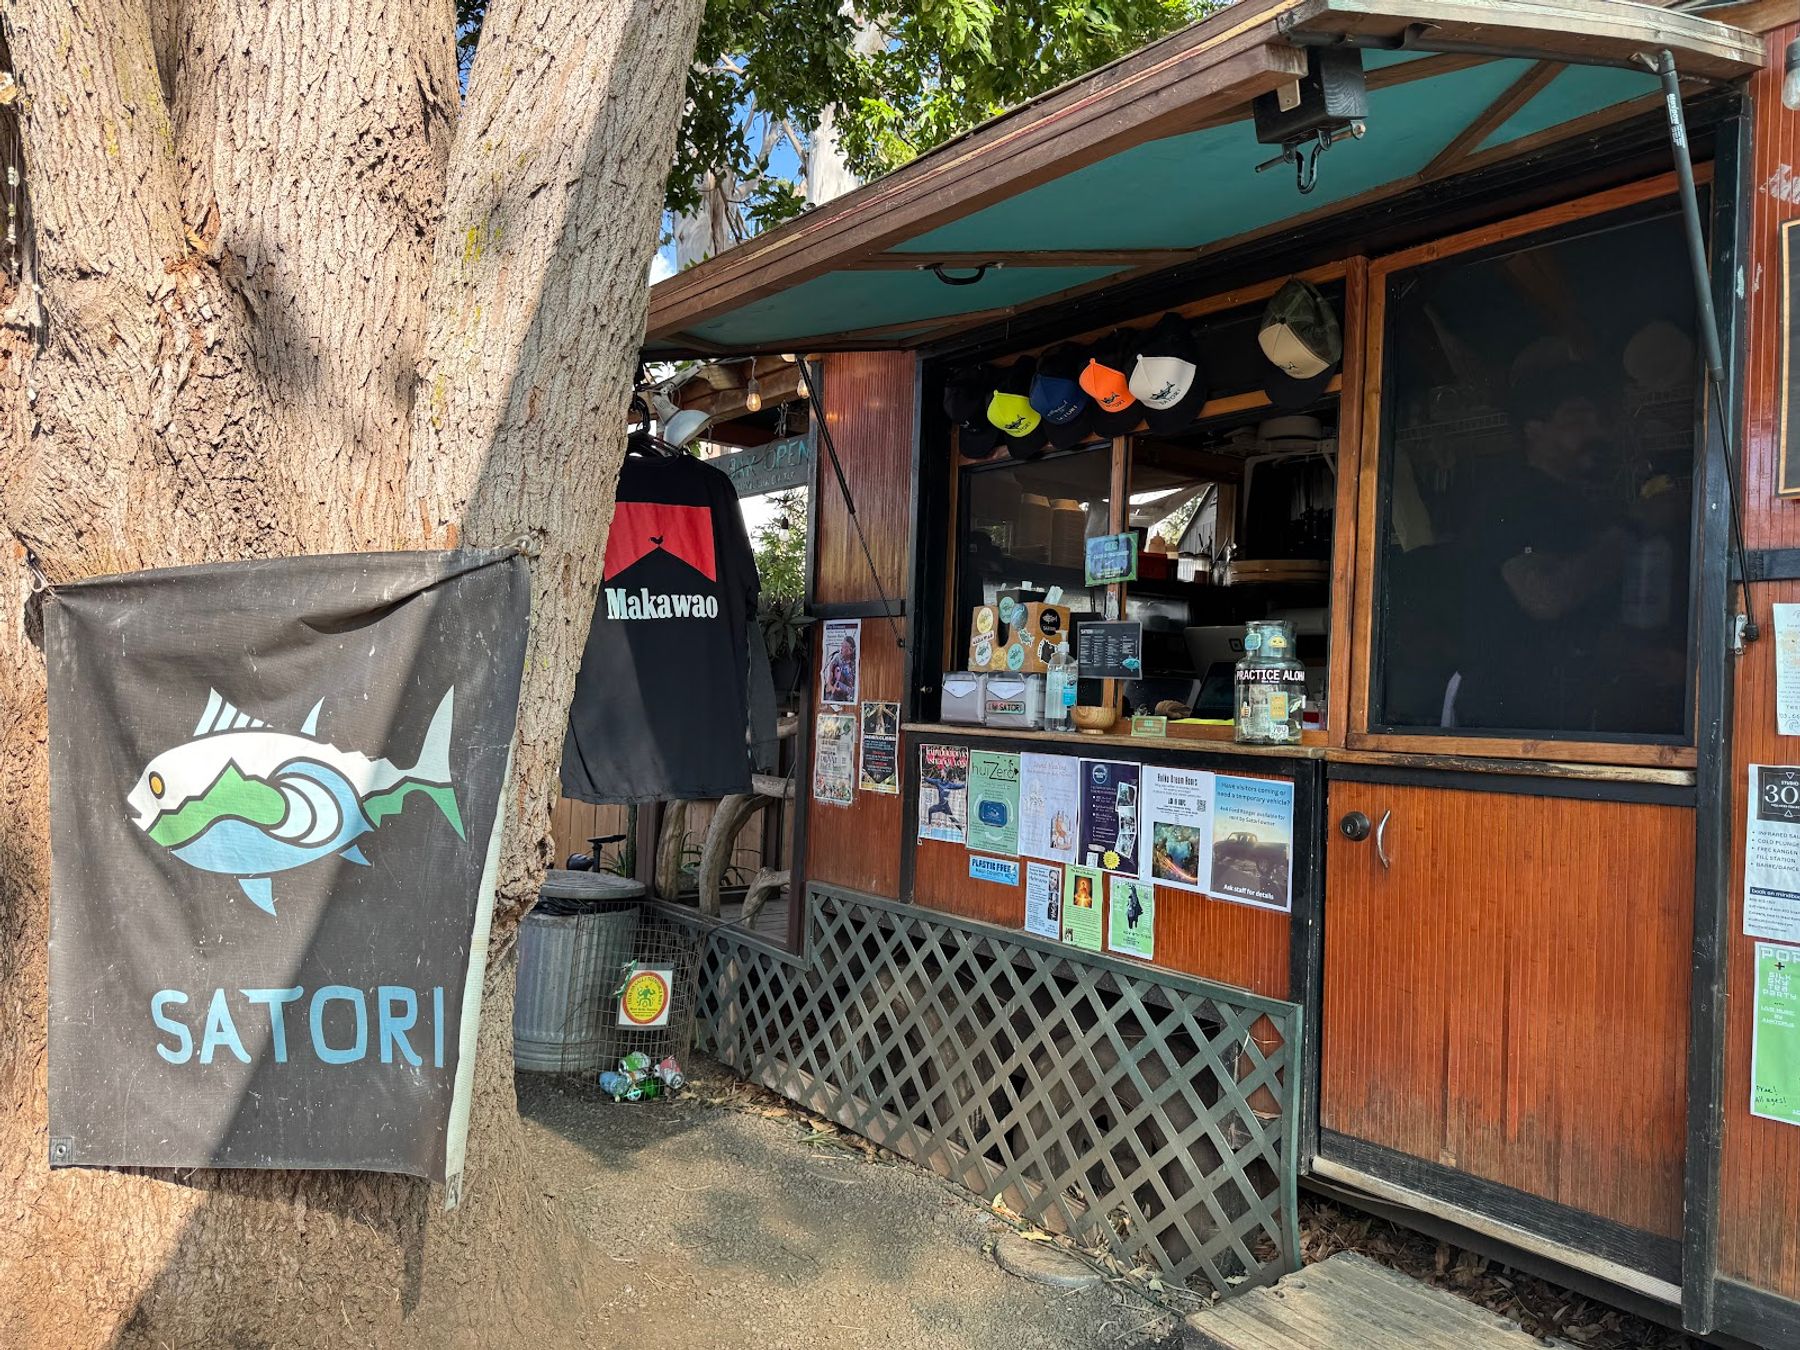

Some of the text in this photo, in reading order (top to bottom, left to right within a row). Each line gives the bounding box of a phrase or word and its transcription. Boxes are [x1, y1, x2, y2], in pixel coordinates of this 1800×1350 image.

[604, 588, 718, 619] Makawao
[1236, 669, 1280, 681] PRACTICE
[151, 985, 443, 1068] SATORI
